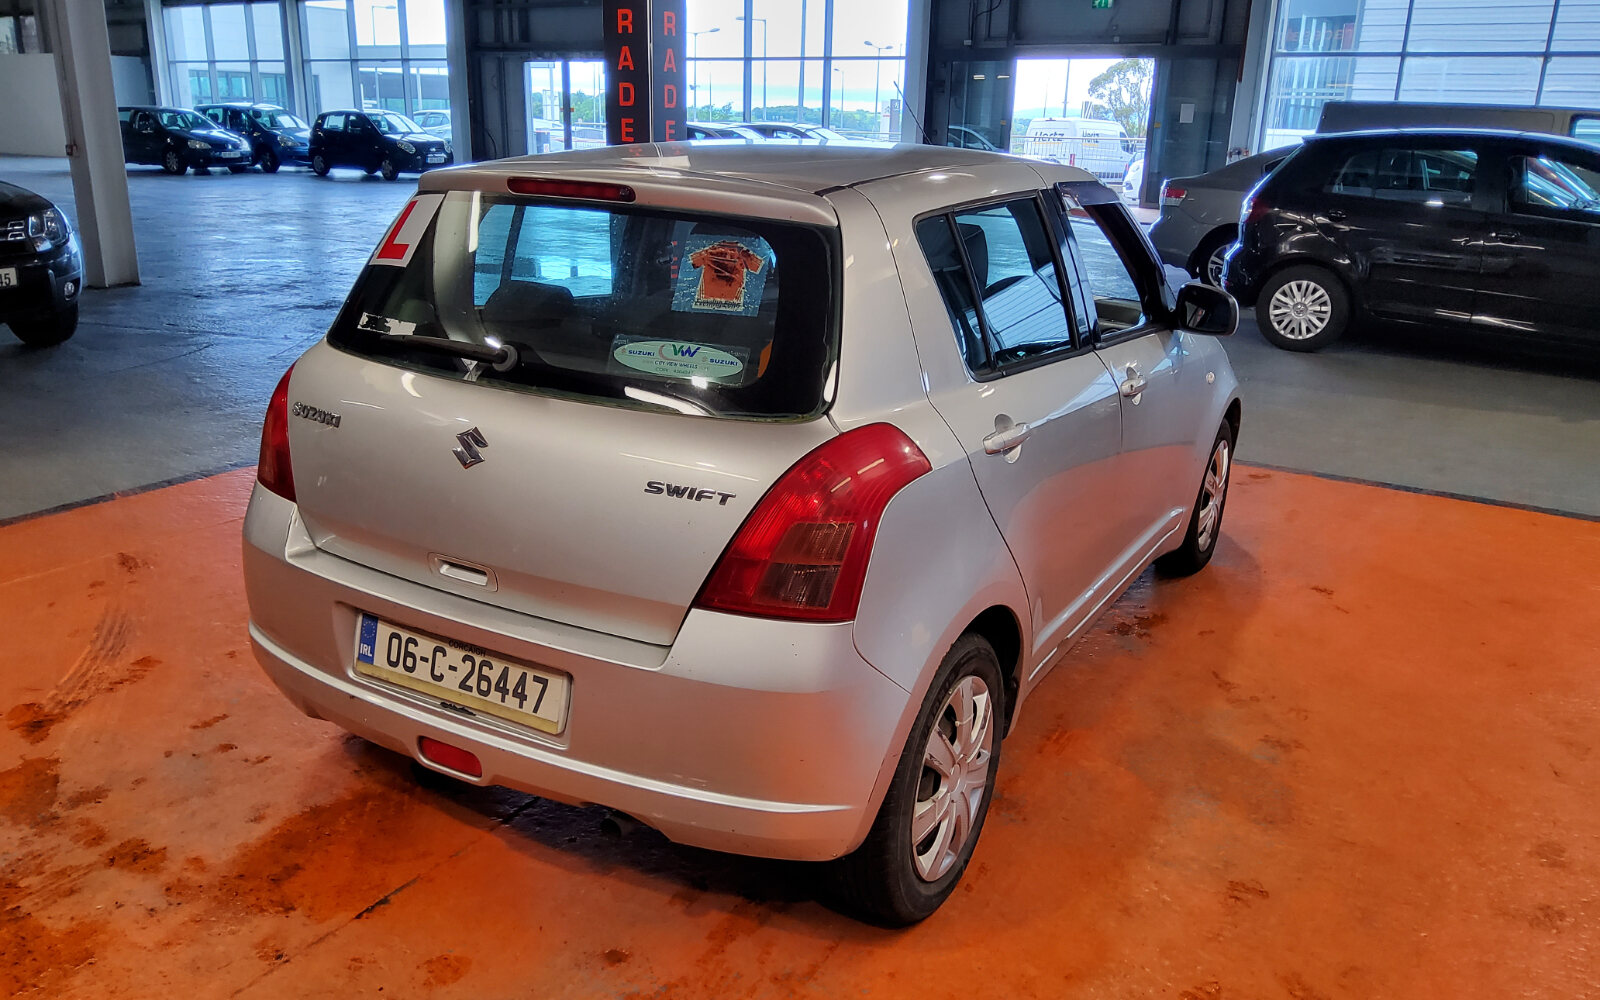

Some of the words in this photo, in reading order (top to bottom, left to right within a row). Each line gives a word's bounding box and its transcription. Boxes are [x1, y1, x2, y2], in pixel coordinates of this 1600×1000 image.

[1033, 131, 1064, 142] Hertz
[376, 200, 419, 260] L
[628, 349, 655, 357] SUZUKI
[709, 358, 738, 367] SUZUKI
[292, 402, 341, 428] SUZUKI
[644, 481, 736, 506] SWIFT
[359, 643, 373, 657] IRL
[448, 640, 487, 657] CORCAIGH
[386, 632, 549, 714] 06-C-26447
